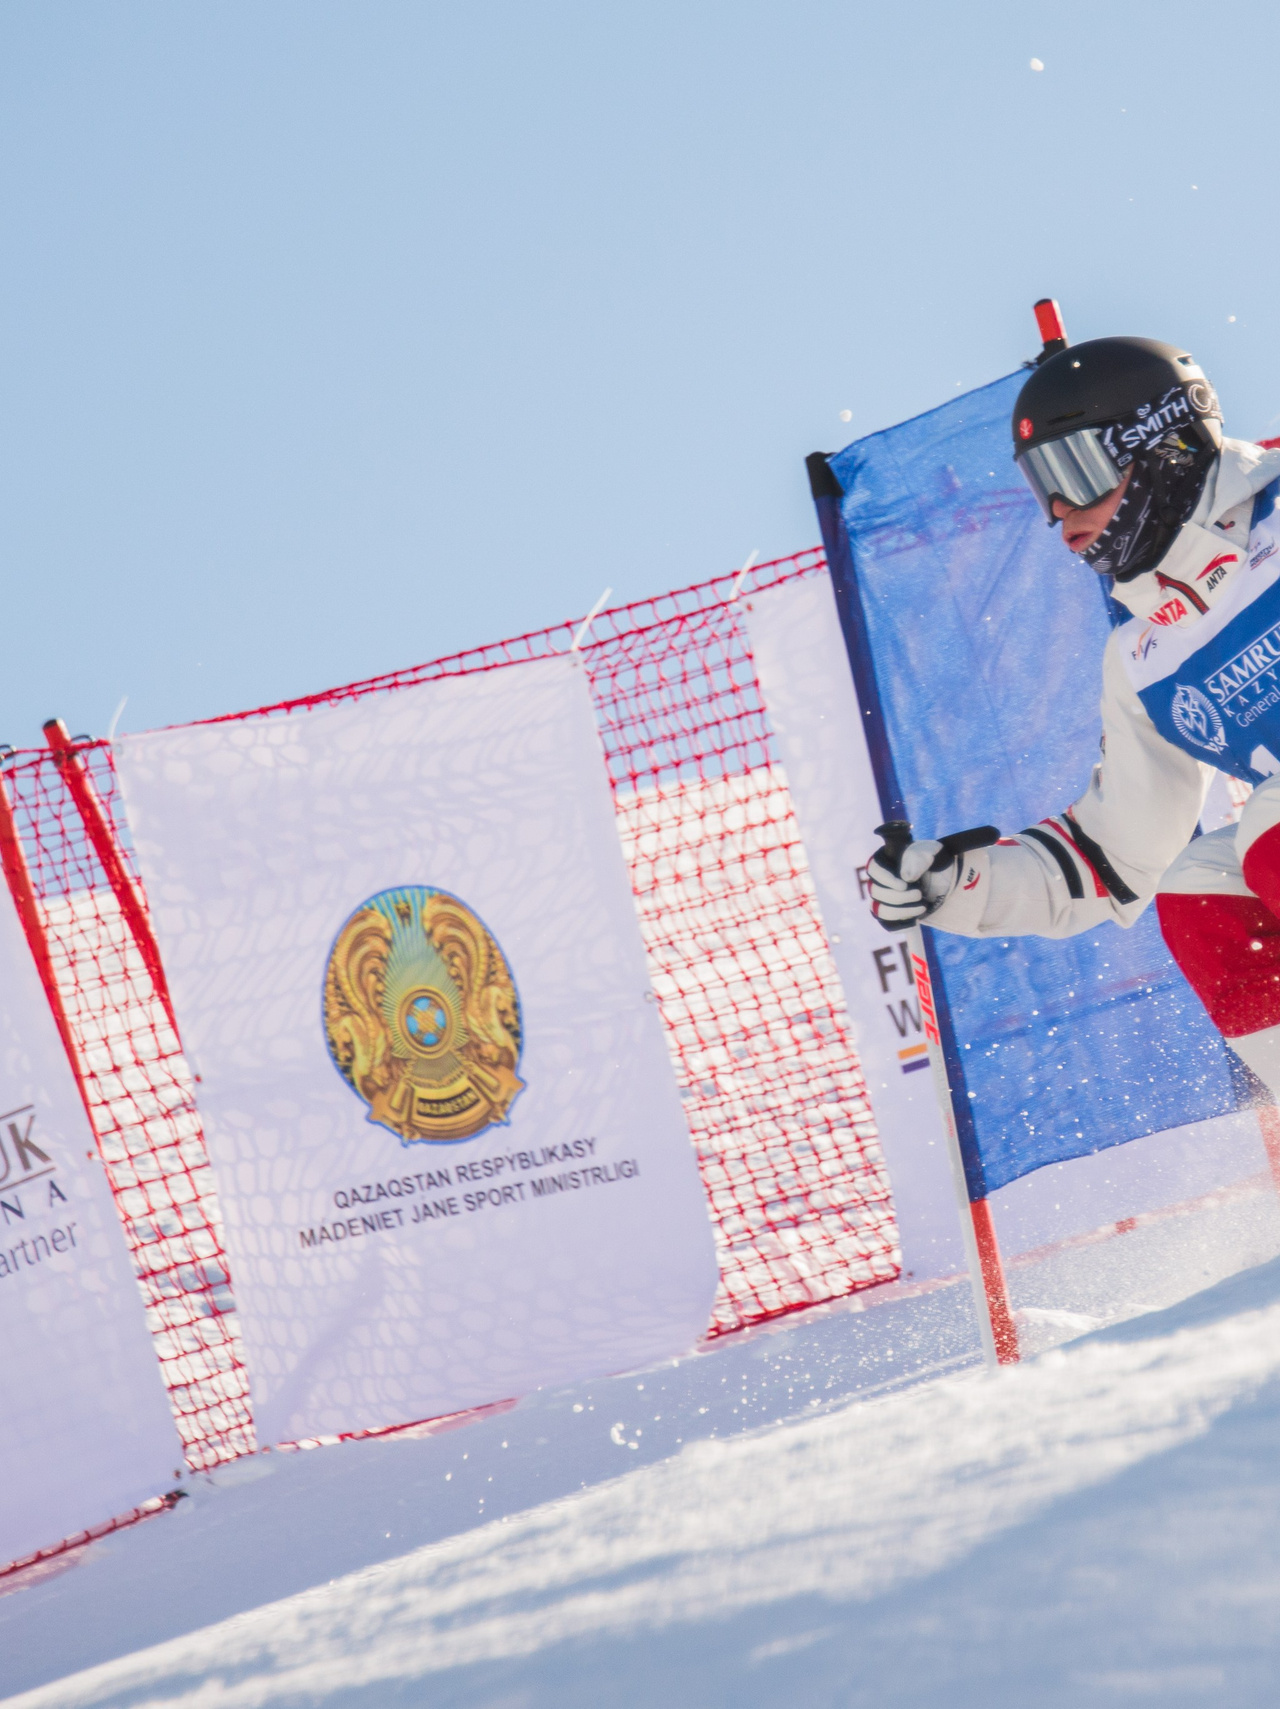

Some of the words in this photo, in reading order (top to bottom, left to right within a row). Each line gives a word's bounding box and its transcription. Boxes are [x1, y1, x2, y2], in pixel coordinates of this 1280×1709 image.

[1121, 397, 1189, 448] SMITH
[1206, 566, 1228, 592] ANTA
[334, 1168, 453, 1209] QAZAQSTAN
[463, 1182, 524, 1212] SPORT
[531, 1158, 640, 1198] MINISTRLIGI
